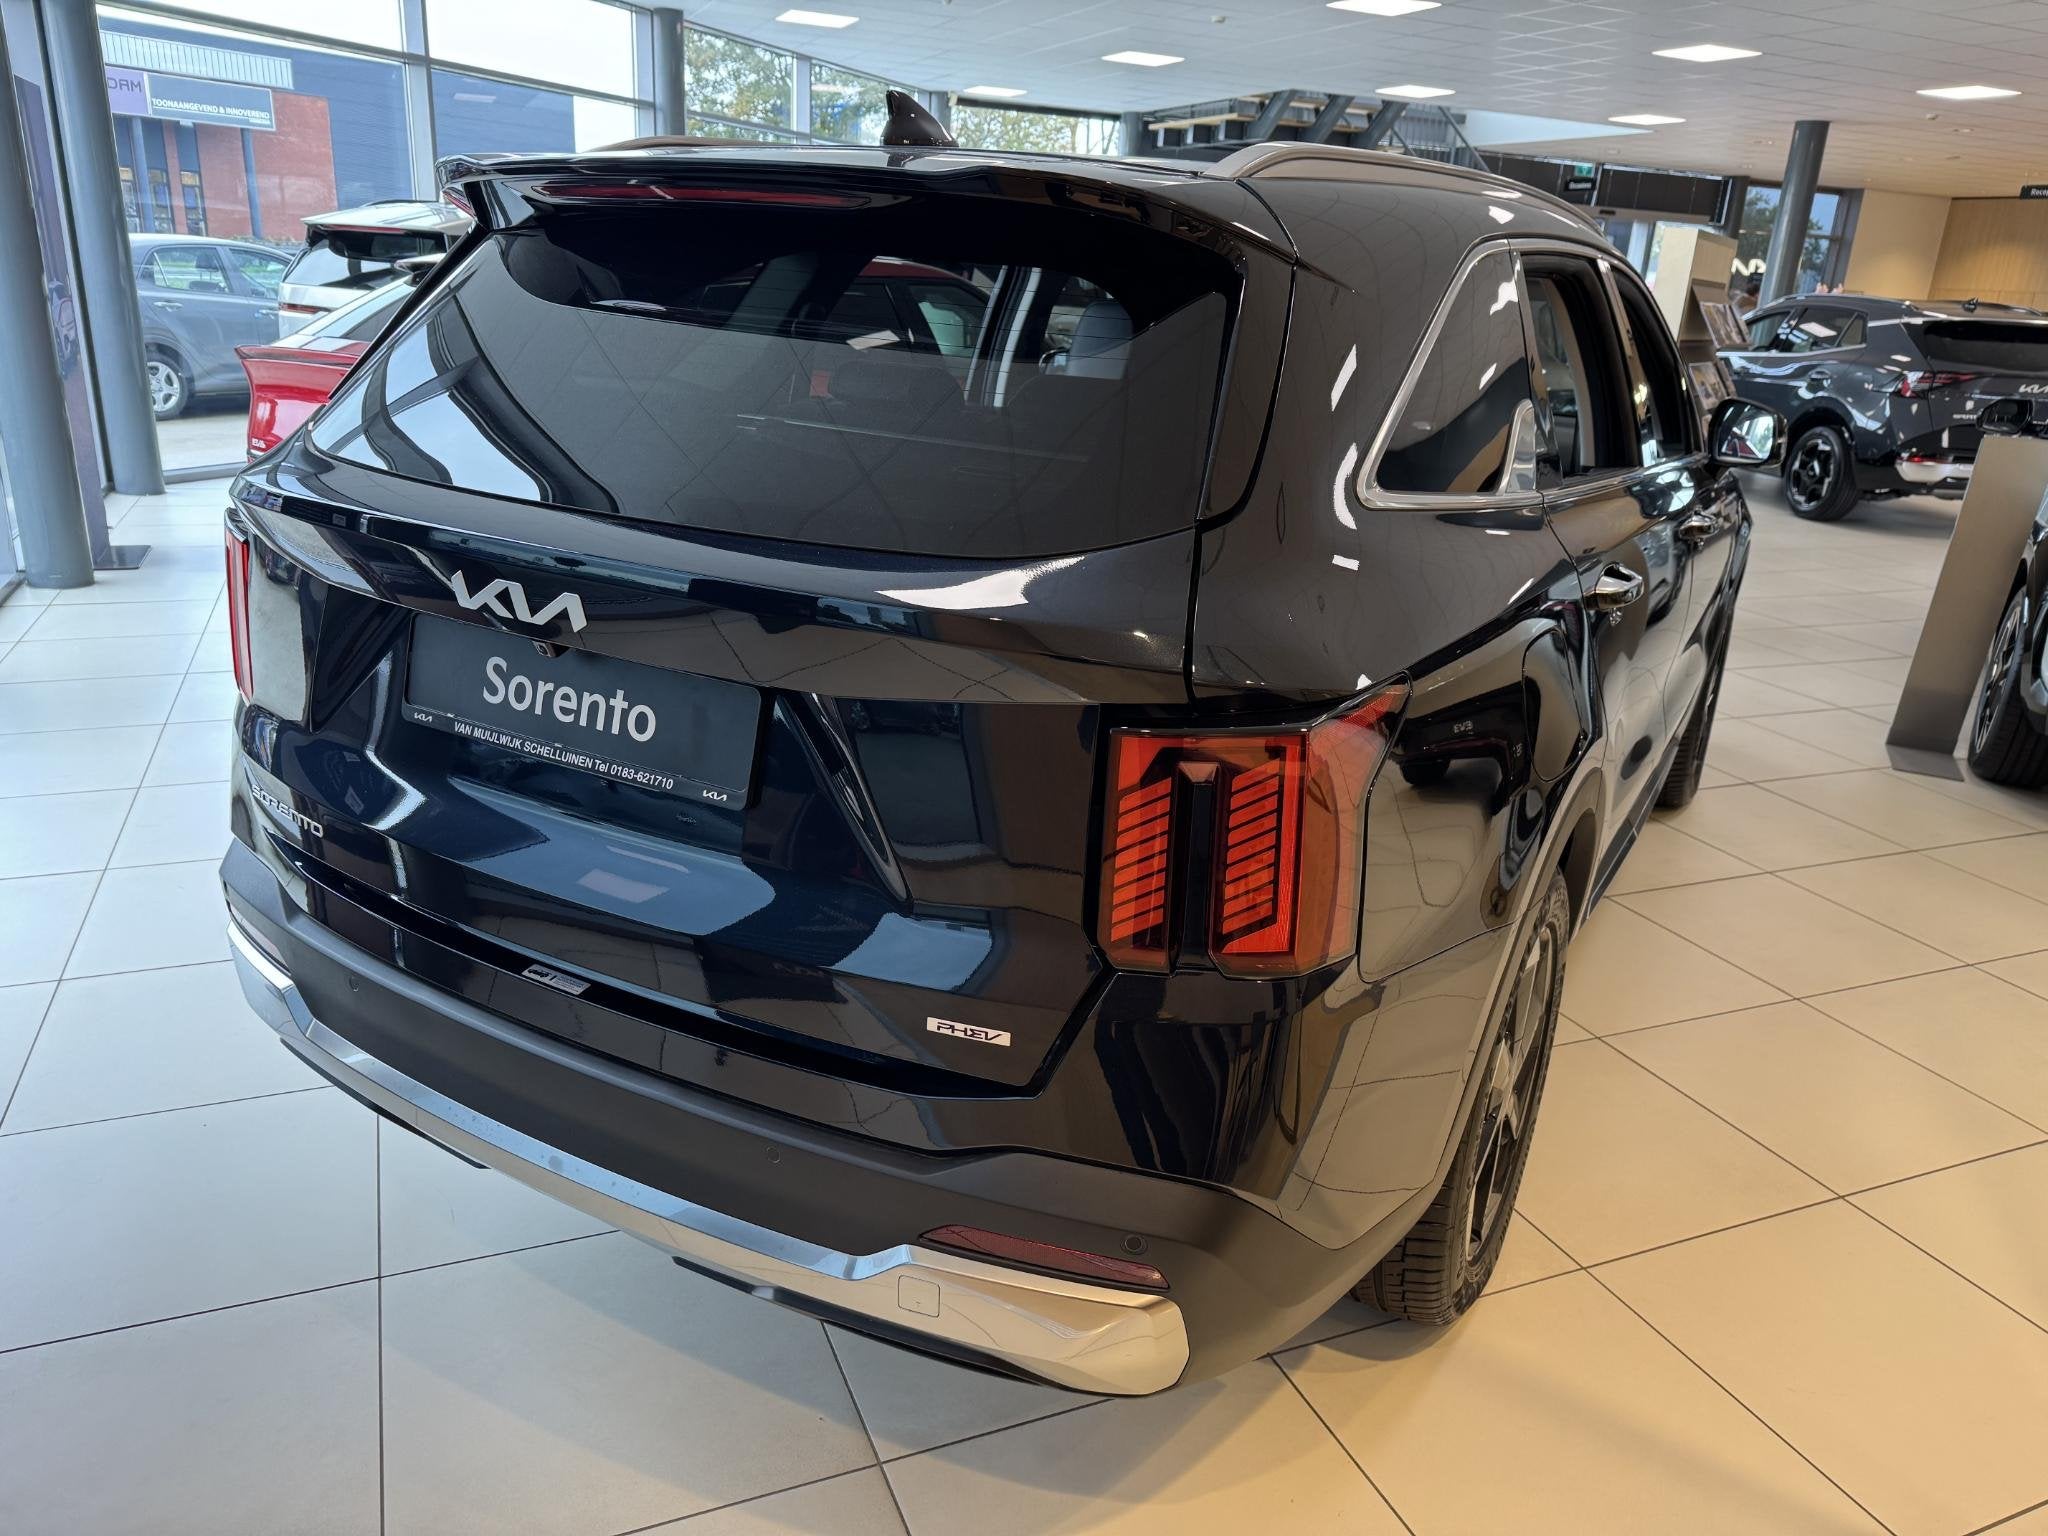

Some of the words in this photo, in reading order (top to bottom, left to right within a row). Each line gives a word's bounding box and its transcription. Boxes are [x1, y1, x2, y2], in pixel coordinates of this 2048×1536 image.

[152, 98, 218, 113] TOONAANGEVEND
[219, 105, 225, 114] &
[226, 106, 270, 119] INNOVEREND
[2030, 188, 2048, 197] Rece
[451, 570, 588, 633] KIA
[482, 656, 657, 742] Sorento
[414, 712, 433, 723] KIA
[454, 721, 473, 736] VAN
[473, 727, 522, 750] MUIJLWIJK
[523, 741, 594, 769] SCHELLUINEN
[594, 759, 610, 773] Tel
[610, 764, 674, 790] 0183-621710
[703, 789, 728, 801] KIA
[252, 784, 324, 839] SORENTO
[936, 1021, 1004, 1041] PHEV
